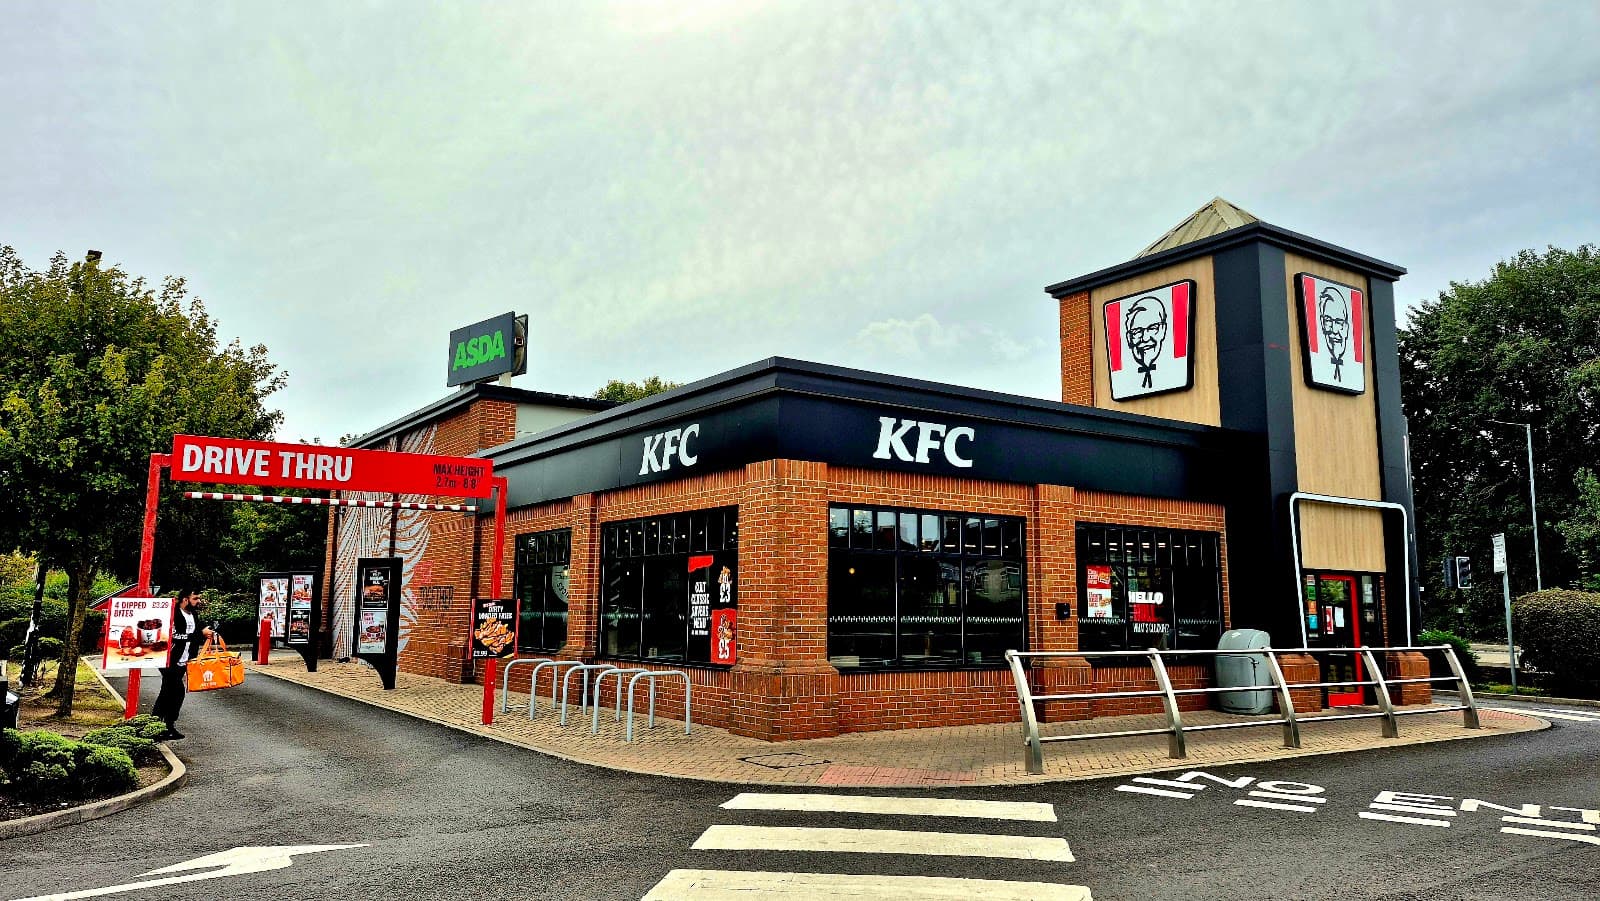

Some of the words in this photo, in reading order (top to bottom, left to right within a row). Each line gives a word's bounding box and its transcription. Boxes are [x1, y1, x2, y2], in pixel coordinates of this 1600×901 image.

[453, 330, 505, 371] ASDA
[639, 423, 699, 475] KFC
[873, 416, 975, 468] KFC
[182, 444, 270, 477] DRIVE
[278, 451, 353, 481] THRU
[433, 464, 452, 475] MAX
[455, 465, 485, 477] HEIGHT
[720, 583, 731, 603] £3
[1128, 591, 1164, 605] HELLO
[113, 609, 134, 617] BITES
[114, 601, 120, 609] 4
[121, 601, 147, 609] DIPPED
[719, 639, 730, 659] £5
[1175, 771, 1326, 795] NO
